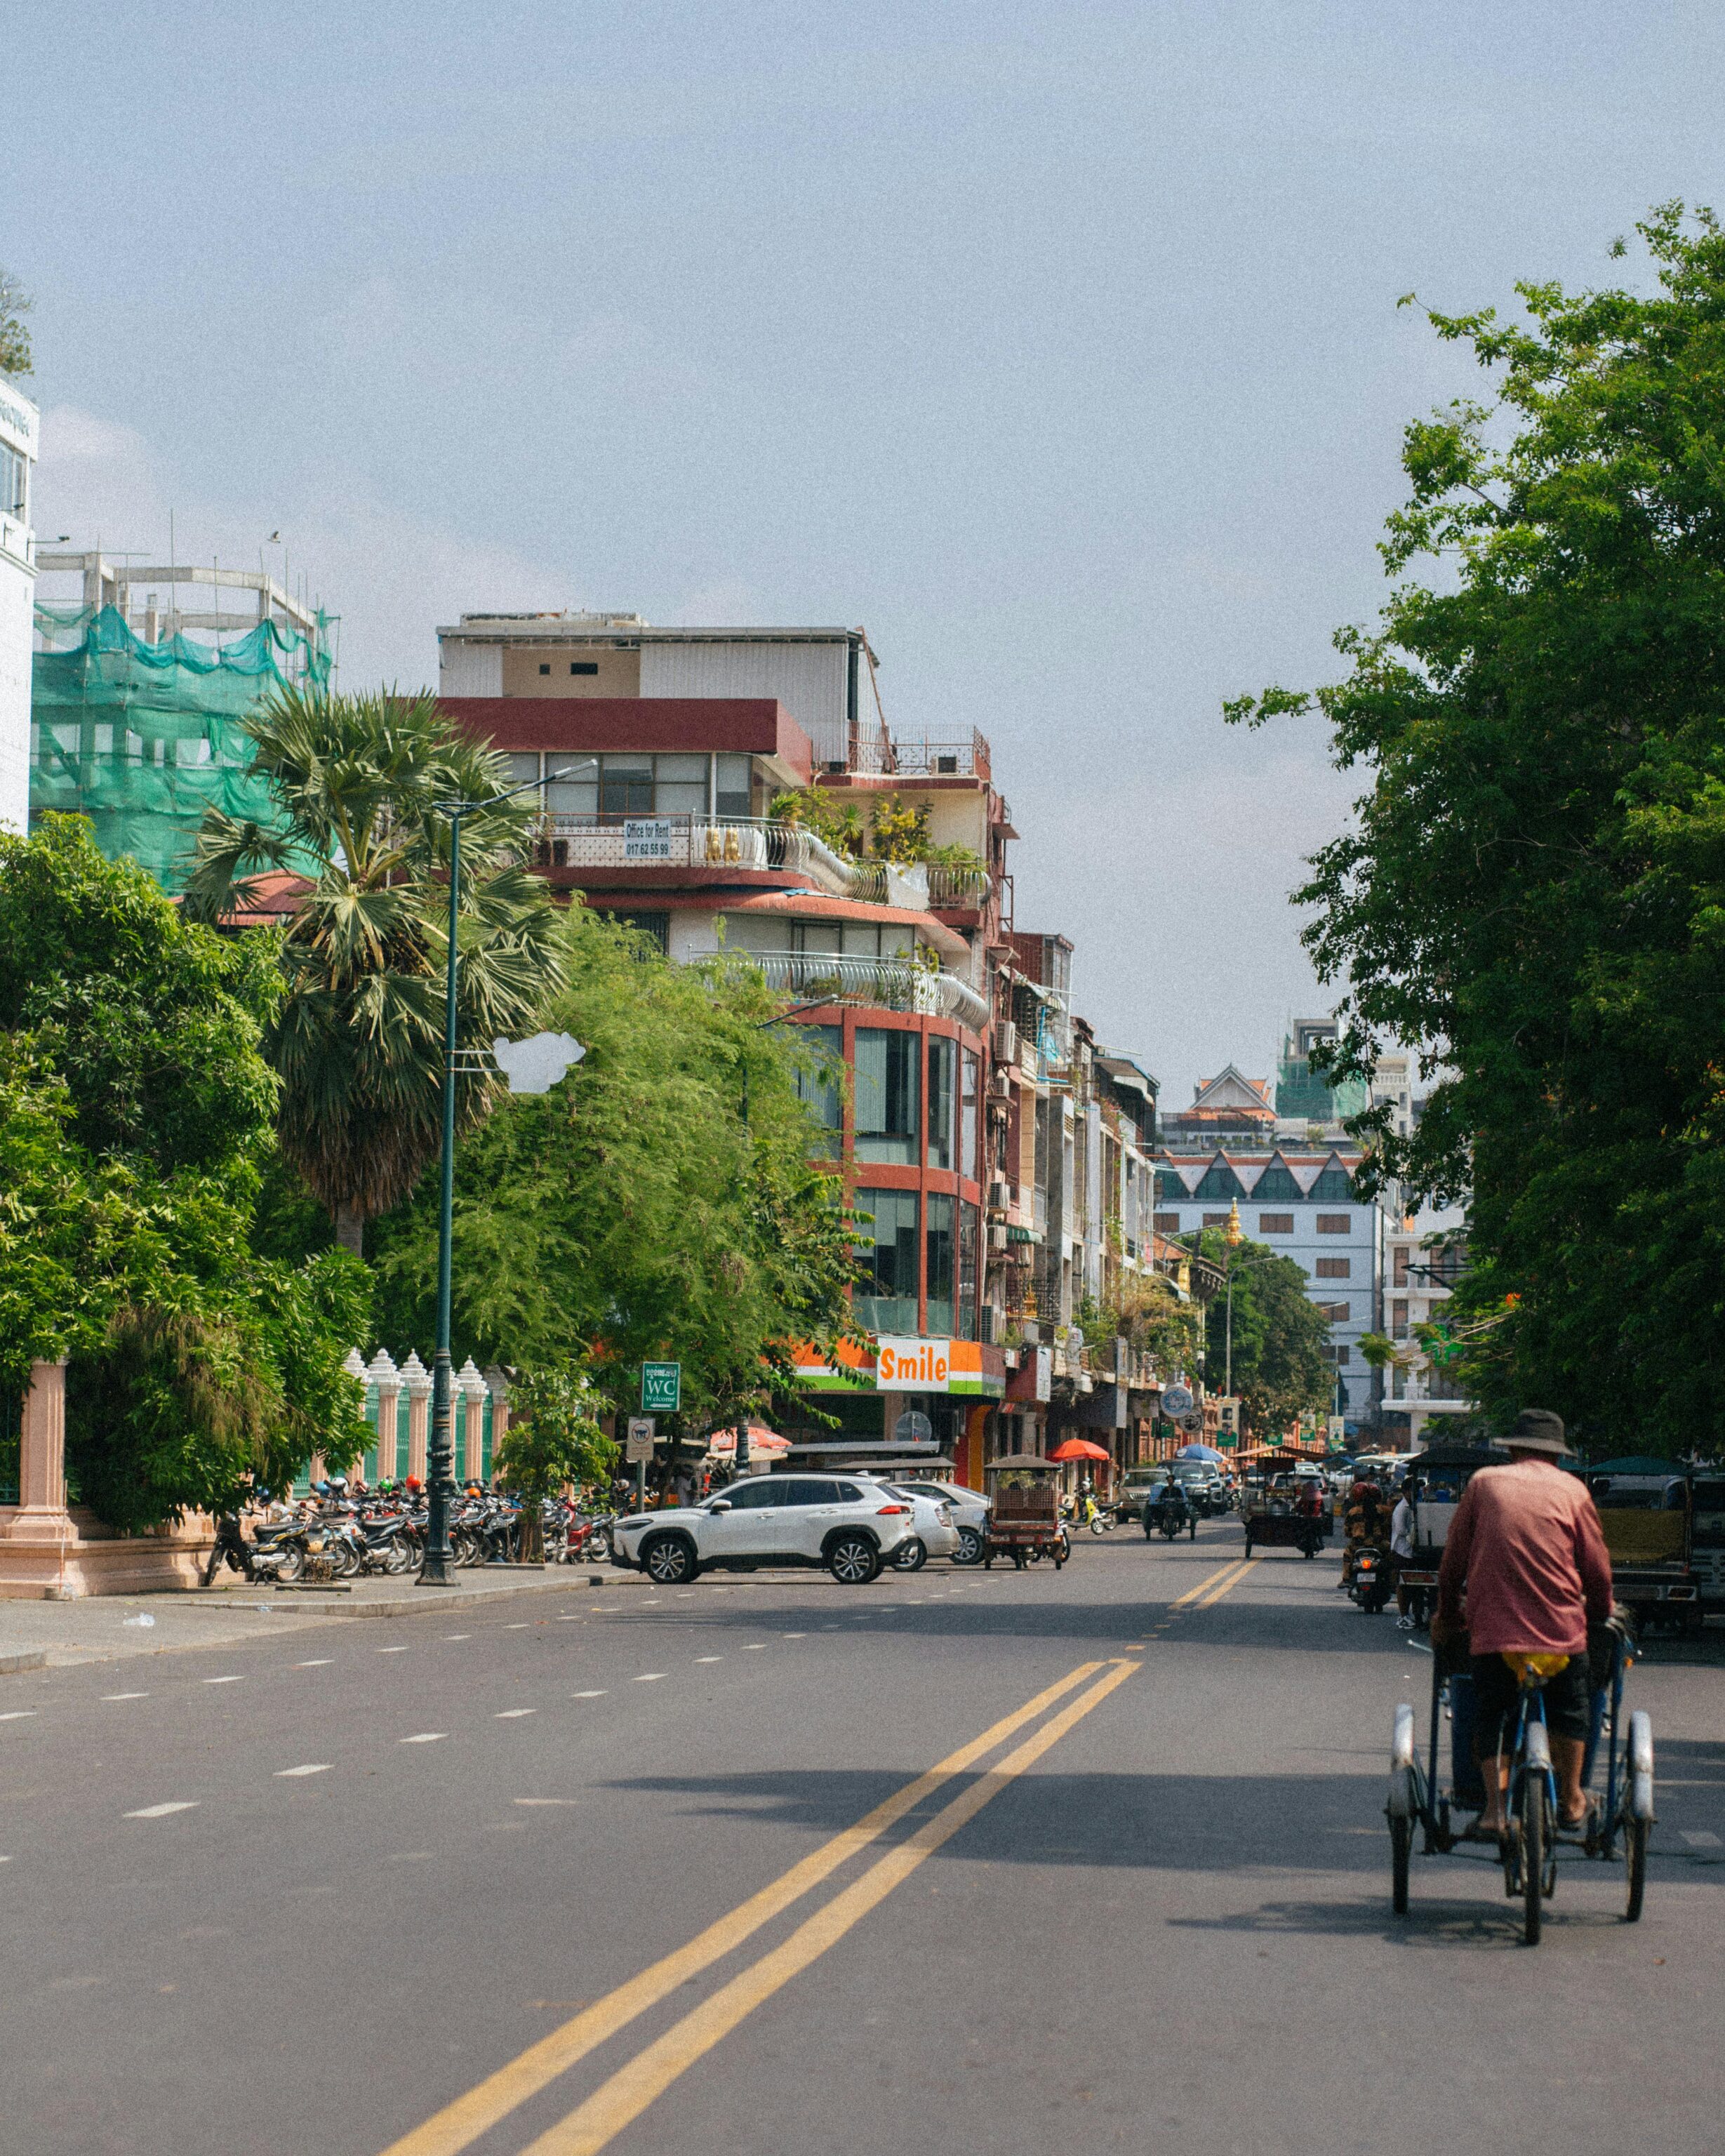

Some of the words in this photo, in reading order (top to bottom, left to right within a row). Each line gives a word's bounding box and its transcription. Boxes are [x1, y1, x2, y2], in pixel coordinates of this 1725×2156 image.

[627, 823, 644, 838] Office
[655, 823, 669, 838] Rent
[627, 844, 639, 855] 017
[640, 844, 649, 855] 62
[651, 844, 659, 855] 55
[660, 844, 669, 855] 99
[880, 1345, 947, 1382] Smile
[647, 1380, 675, 1395] WC
